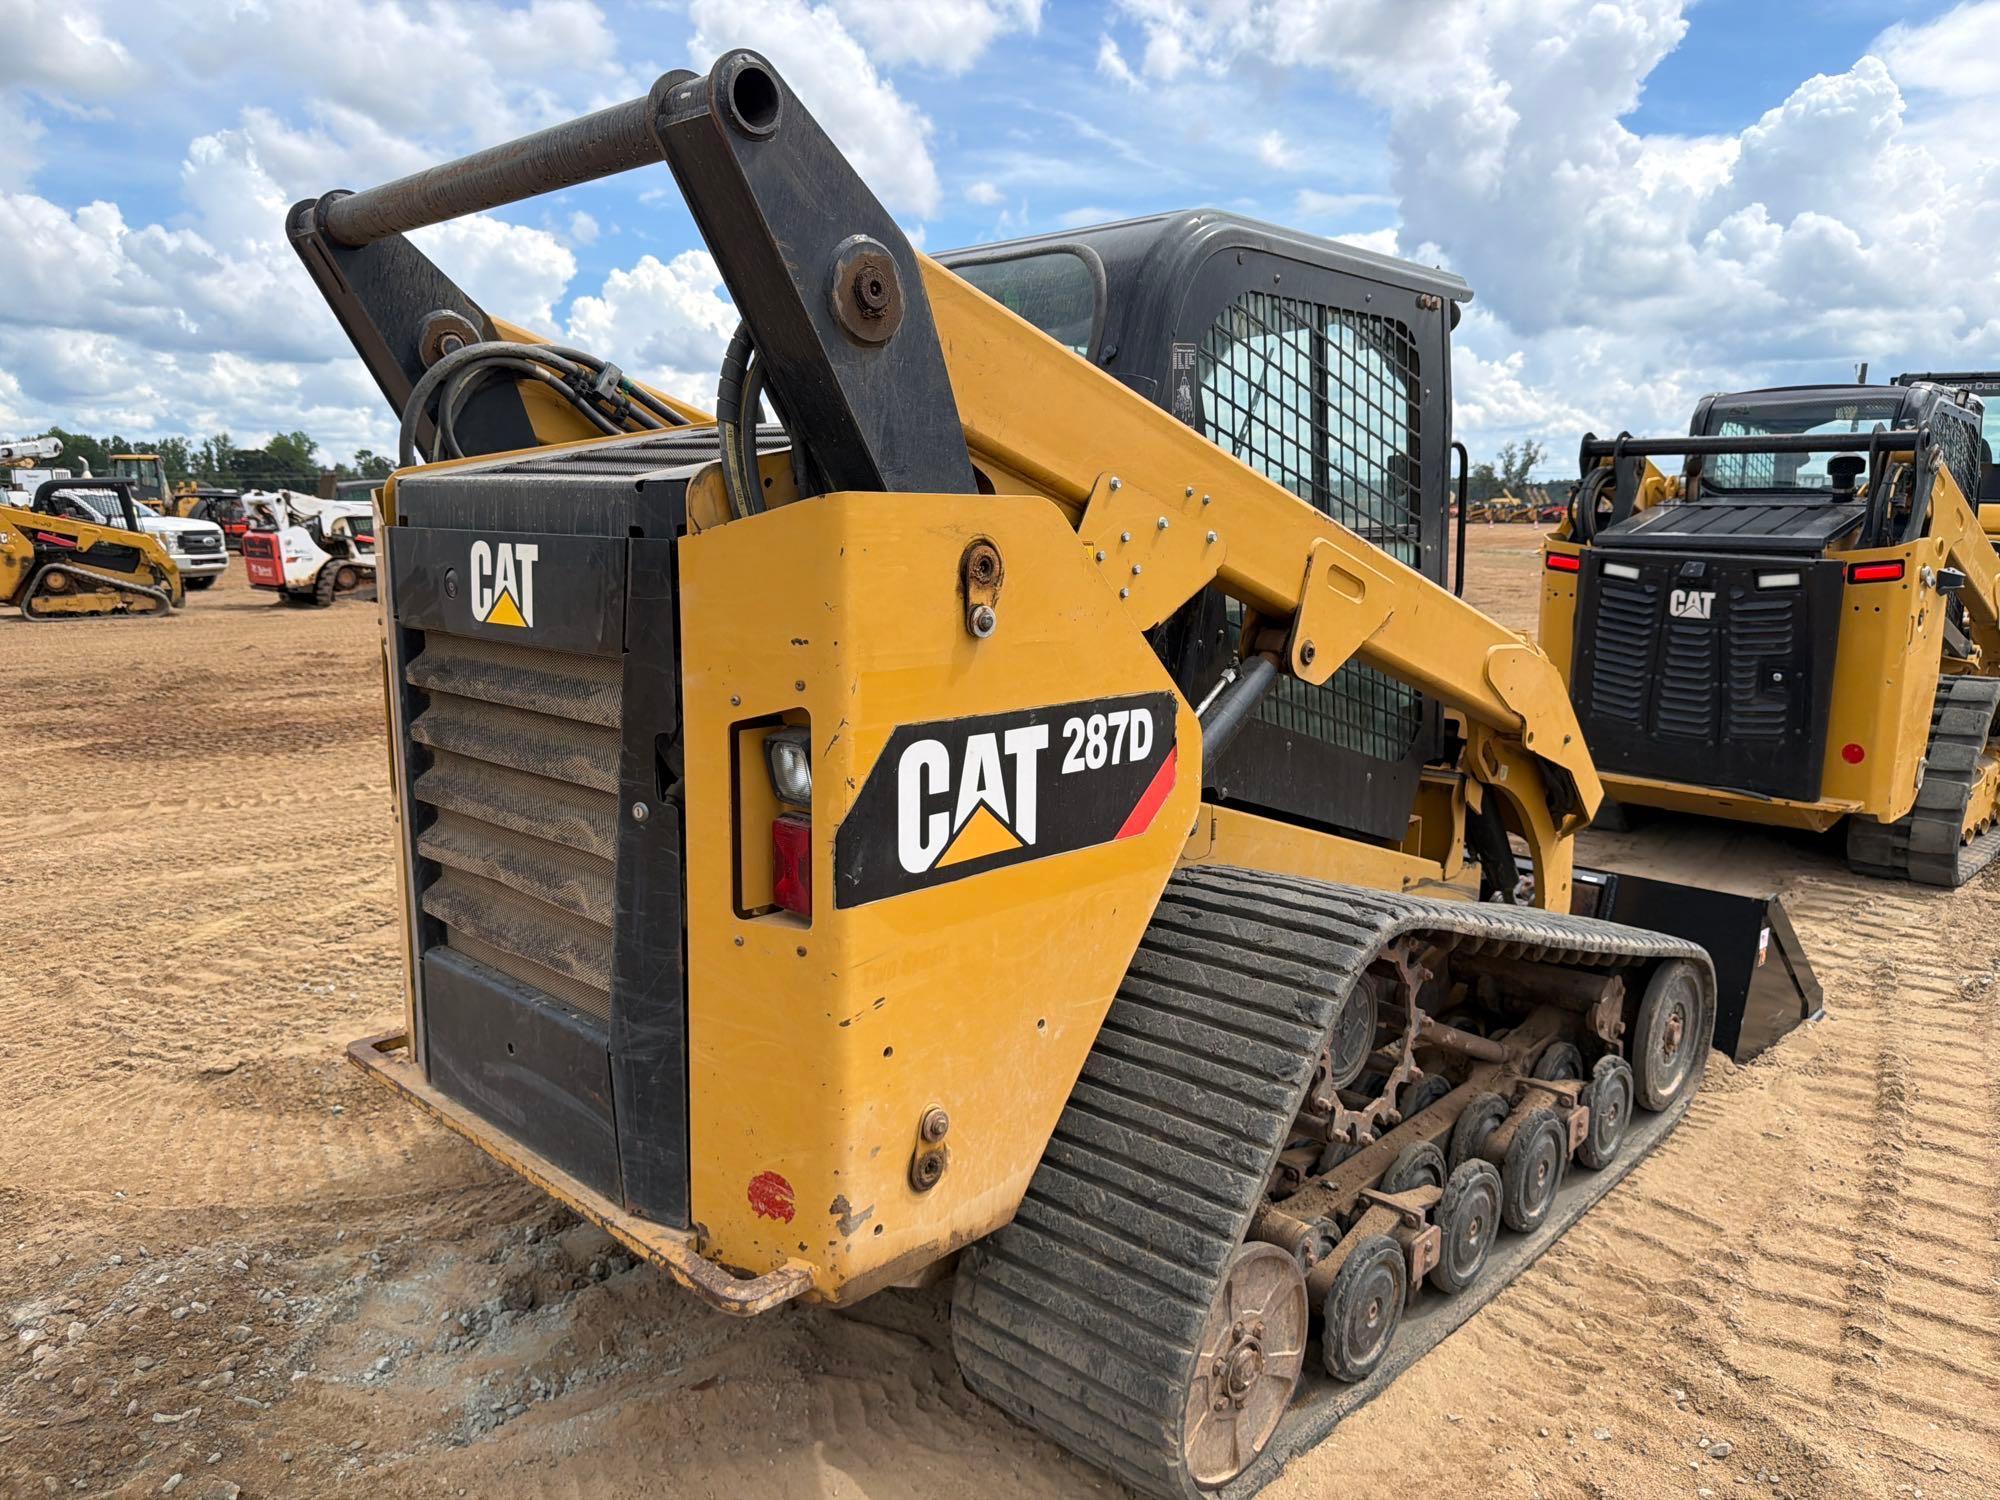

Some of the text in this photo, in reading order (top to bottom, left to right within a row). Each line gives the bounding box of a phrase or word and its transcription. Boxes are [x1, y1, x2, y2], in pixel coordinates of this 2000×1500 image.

[470, 540, 539, 628] CAT
[1669, 588, 1717, 620] CAT
[897, 707, 1154, 874] CAT 287D
